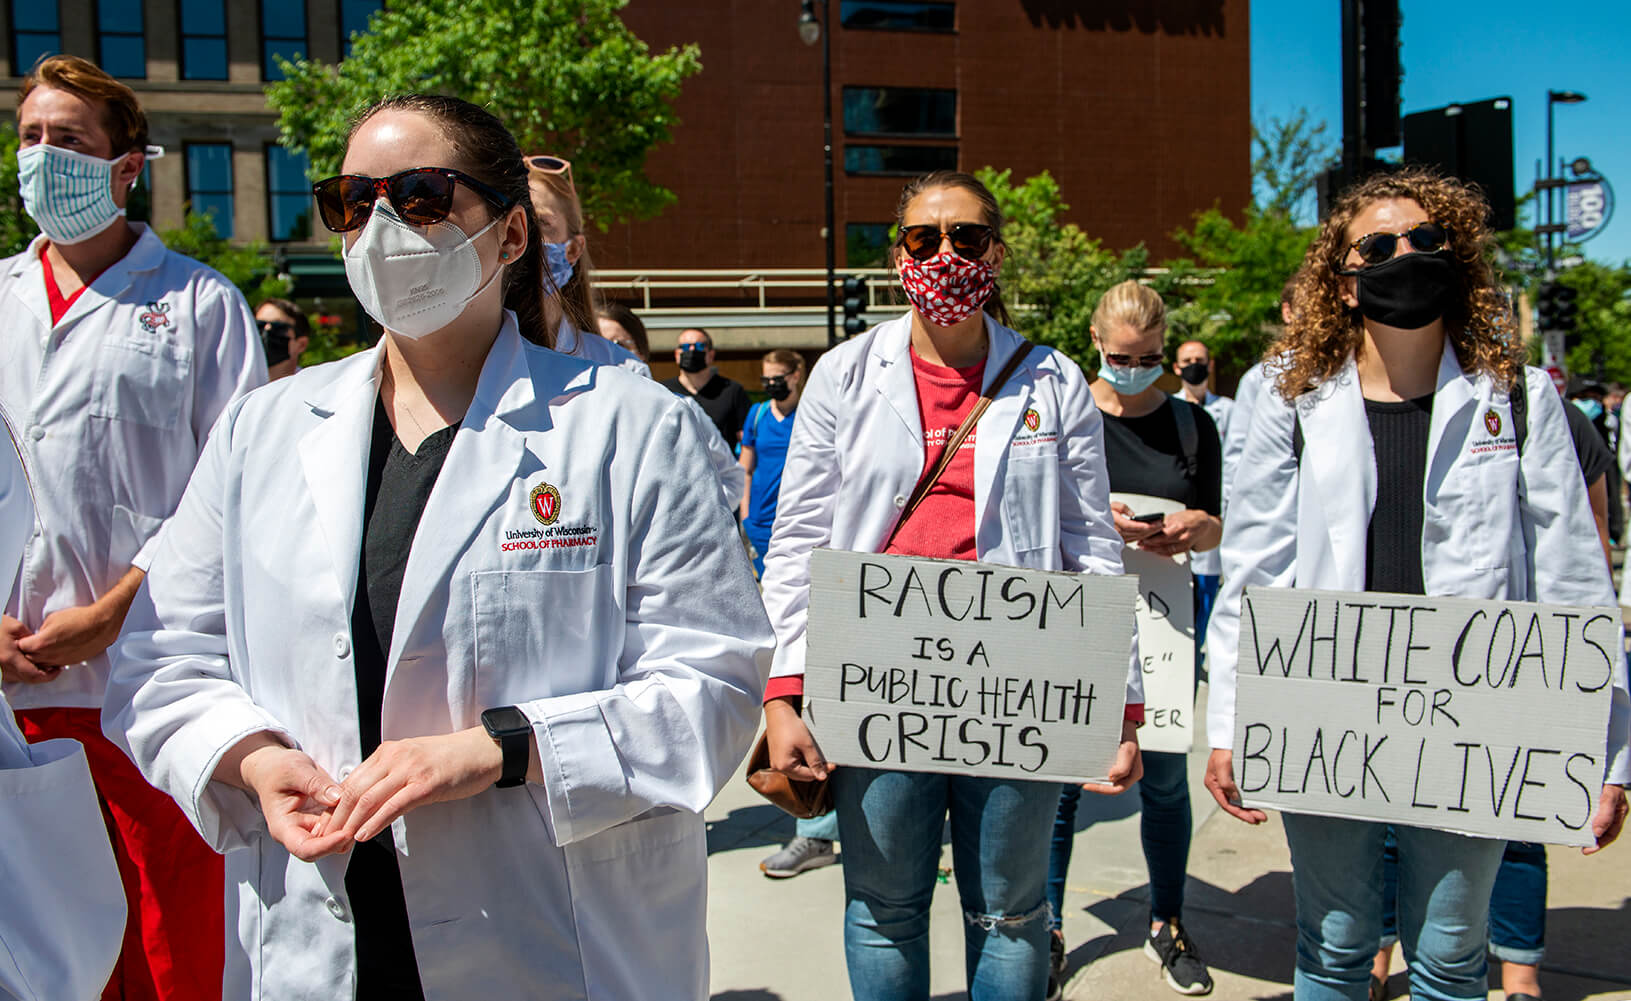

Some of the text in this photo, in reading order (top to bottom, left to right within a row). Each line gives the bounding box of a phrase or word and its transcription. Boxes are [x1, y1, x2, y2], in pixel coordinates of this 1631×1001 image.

[505, 525, 592, 540] University of Wisconsin
[538, 497, 553, 517] W
[501, 540, 539, 552] SCHOOL
[552, 536, 598, 548] PHARMACY
[858, 562, 1085, 630] RACISM
[911, 636, 990, 668] IS A
[1245, 597, 1614, 693] WHITE COATS
[839, 662, 1097, 726] PUBLIC HEALTH
[1376, 687, 1461, 728] FOR
[858, 711, 1049, 773] CRISIS
[1240, 722, 1597, 830] BLACK LIVES
